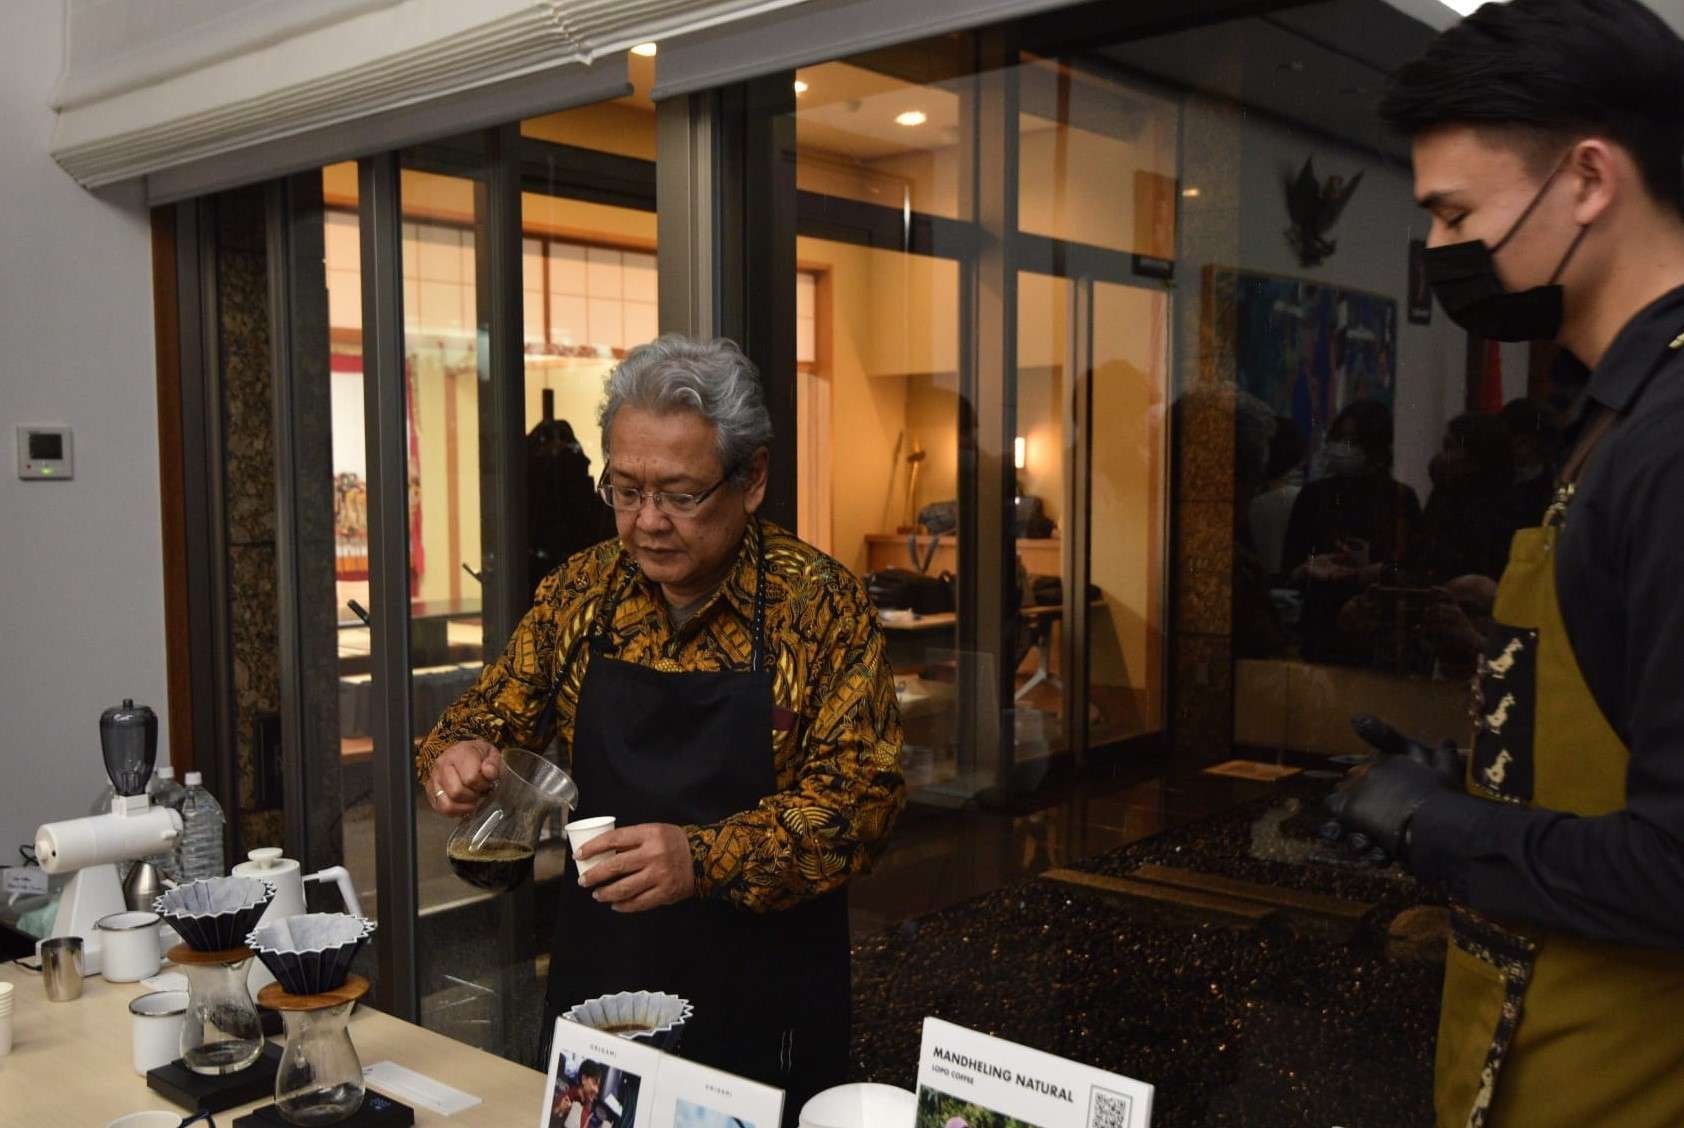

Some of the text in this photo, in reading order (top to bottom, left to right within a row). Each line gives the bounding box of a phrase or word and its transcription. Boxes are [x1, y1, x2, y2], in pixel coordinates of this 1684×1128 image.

[931, 1063, 974, 1085] LOPO COFFEE
[933, 1045, 1074, 1103] MANDHELING NATURAL
